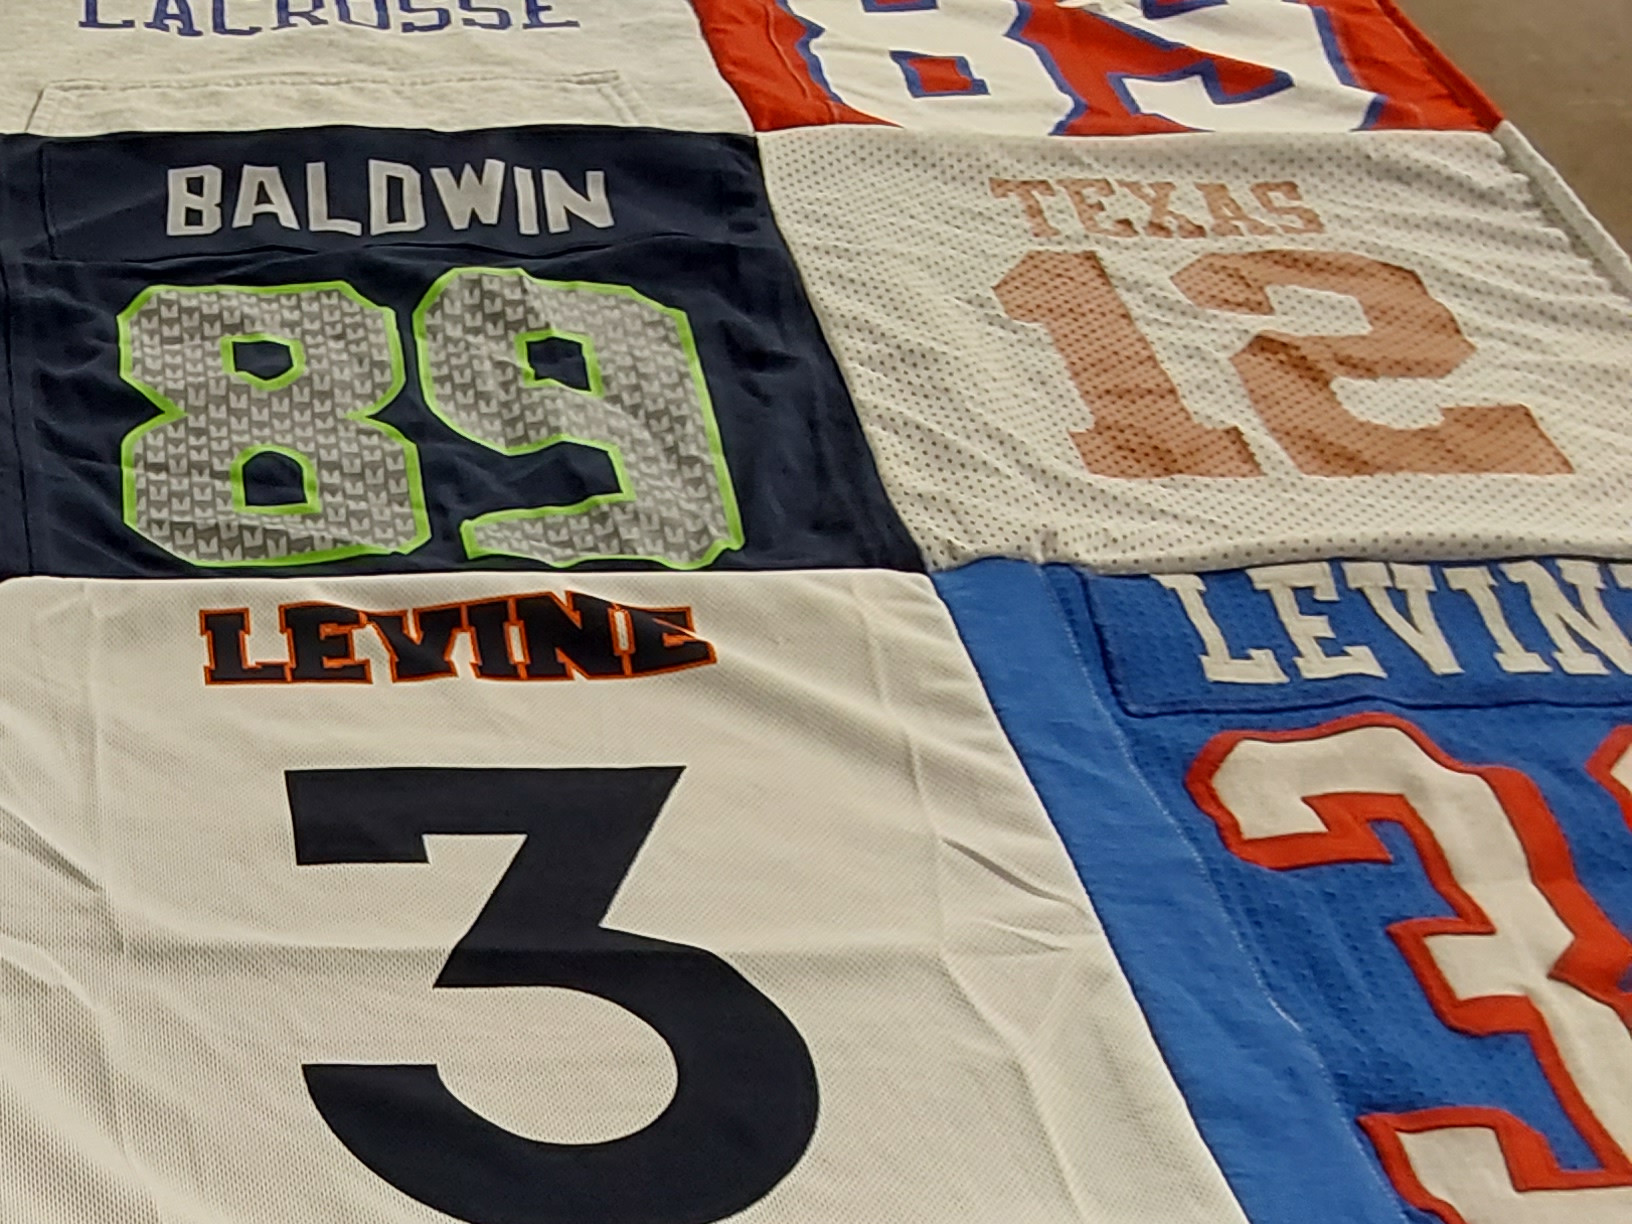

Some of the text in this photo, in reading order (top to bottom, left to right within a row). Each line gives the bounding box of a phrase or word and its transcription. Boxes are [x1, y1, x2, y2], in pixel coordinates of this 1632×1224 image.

[167, 159, 614, 236] BALDWIN
[989, 177, 1325, 239] TEXAS
[992, 250, 1574, 479] 12
[118, 267, 744, 572] 89
[199, 590, 717, 685] LEVINE
